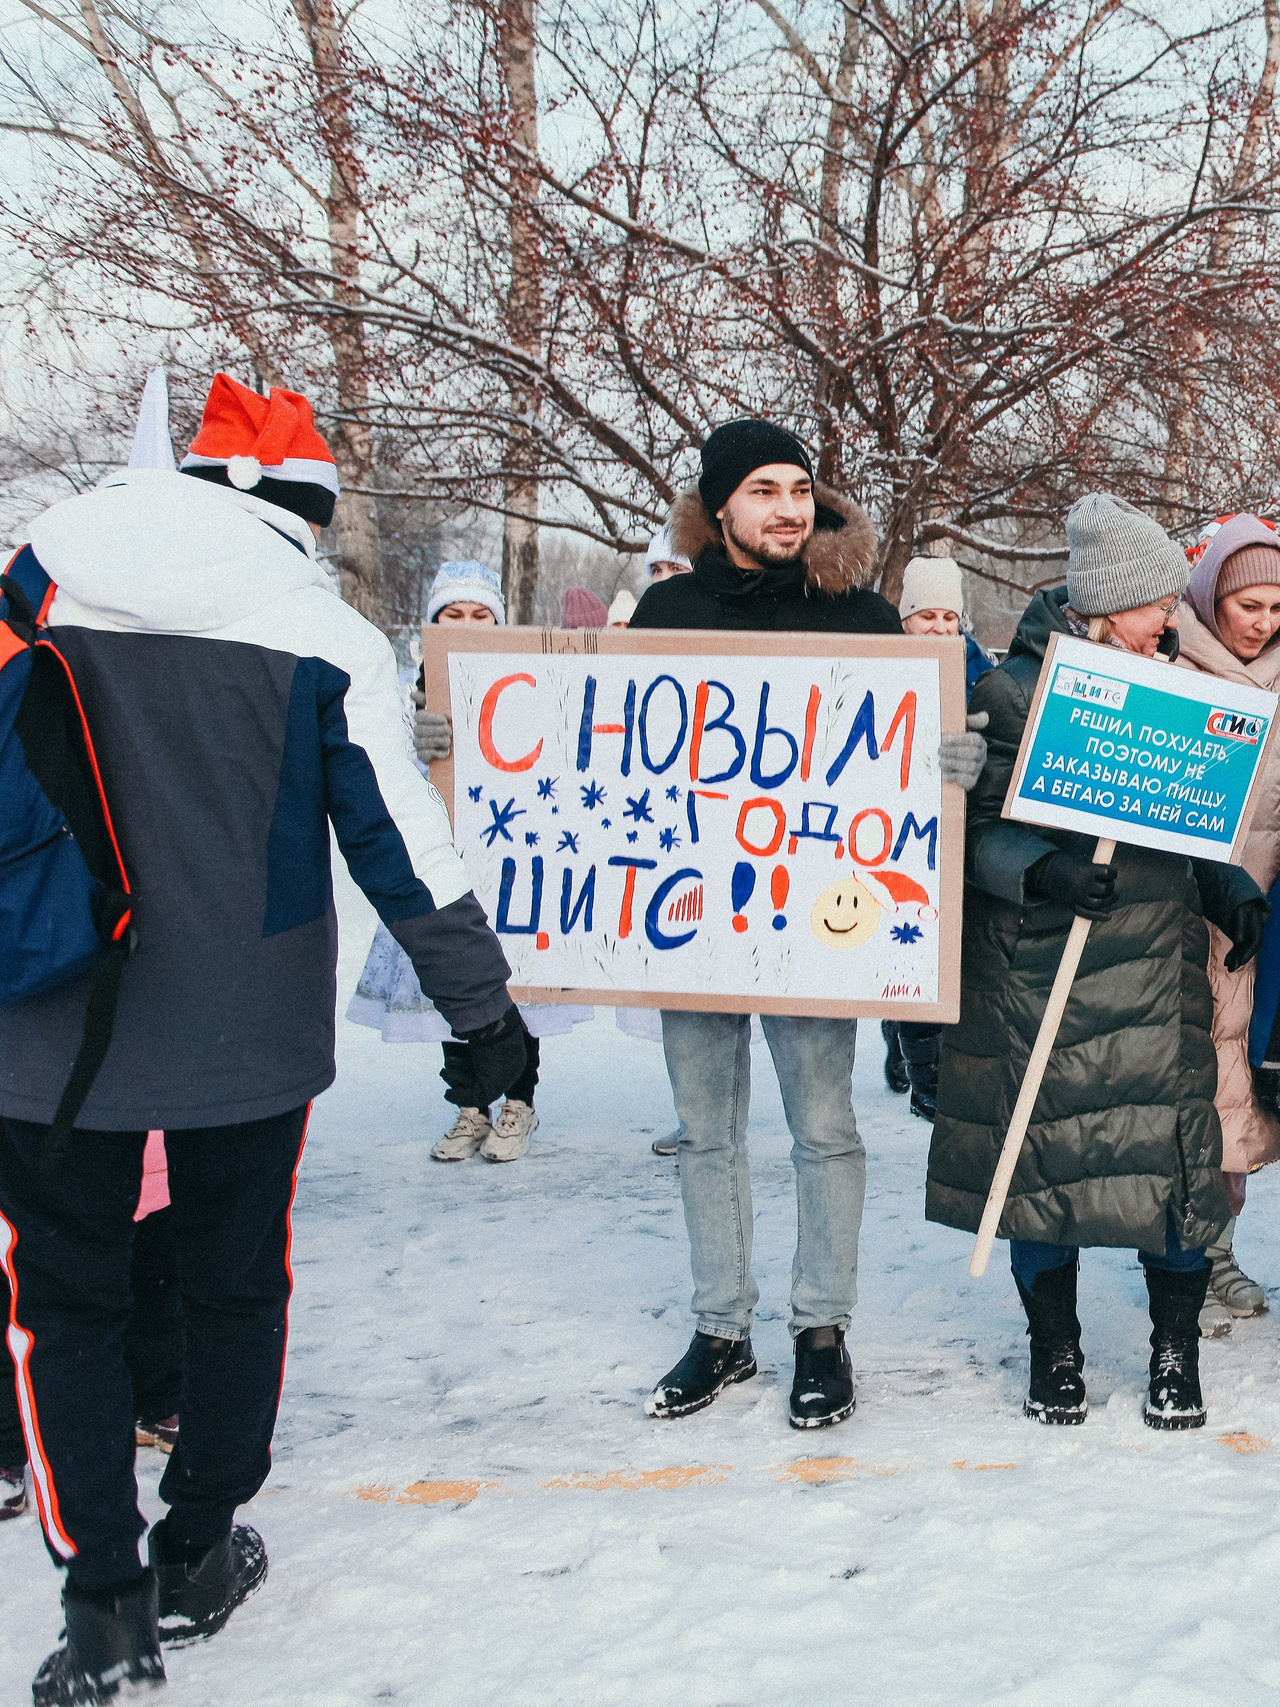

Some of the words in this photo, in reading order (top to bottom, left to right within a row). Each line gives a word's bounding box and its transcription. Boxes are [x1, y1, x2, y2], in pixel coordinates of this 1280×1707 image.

[1074, 681, 1121, 704] ЦИТС
[478, 673, 544, 772] С
[576, 674, 917, 791] НОВЫМ
[1070, 708, 1132, 739] РЕШИЛ
[1139, 725, 1230, 763] ПОХУДЕТЬ,
[1086, 737, 1182, 774] ПОЭТОМУ
[1184, 762, 1206, 781] НЕ
[1032, 776, 1046, 792] А
[1051, 780, 1115, 808] БЕГАЮ
[1119, 796, 1142, 815] ЗА
[1149, 802, 1182, 823] НЕЙ
[1185, 812, 1225, 833] САМ
[1042, 752, 1161, 794] ЗАКАЗЫВАЮ
[1166, 783, 1227, 811] ПИЦЦУ,
[687, 790, 938, 870] ГОДОМ
